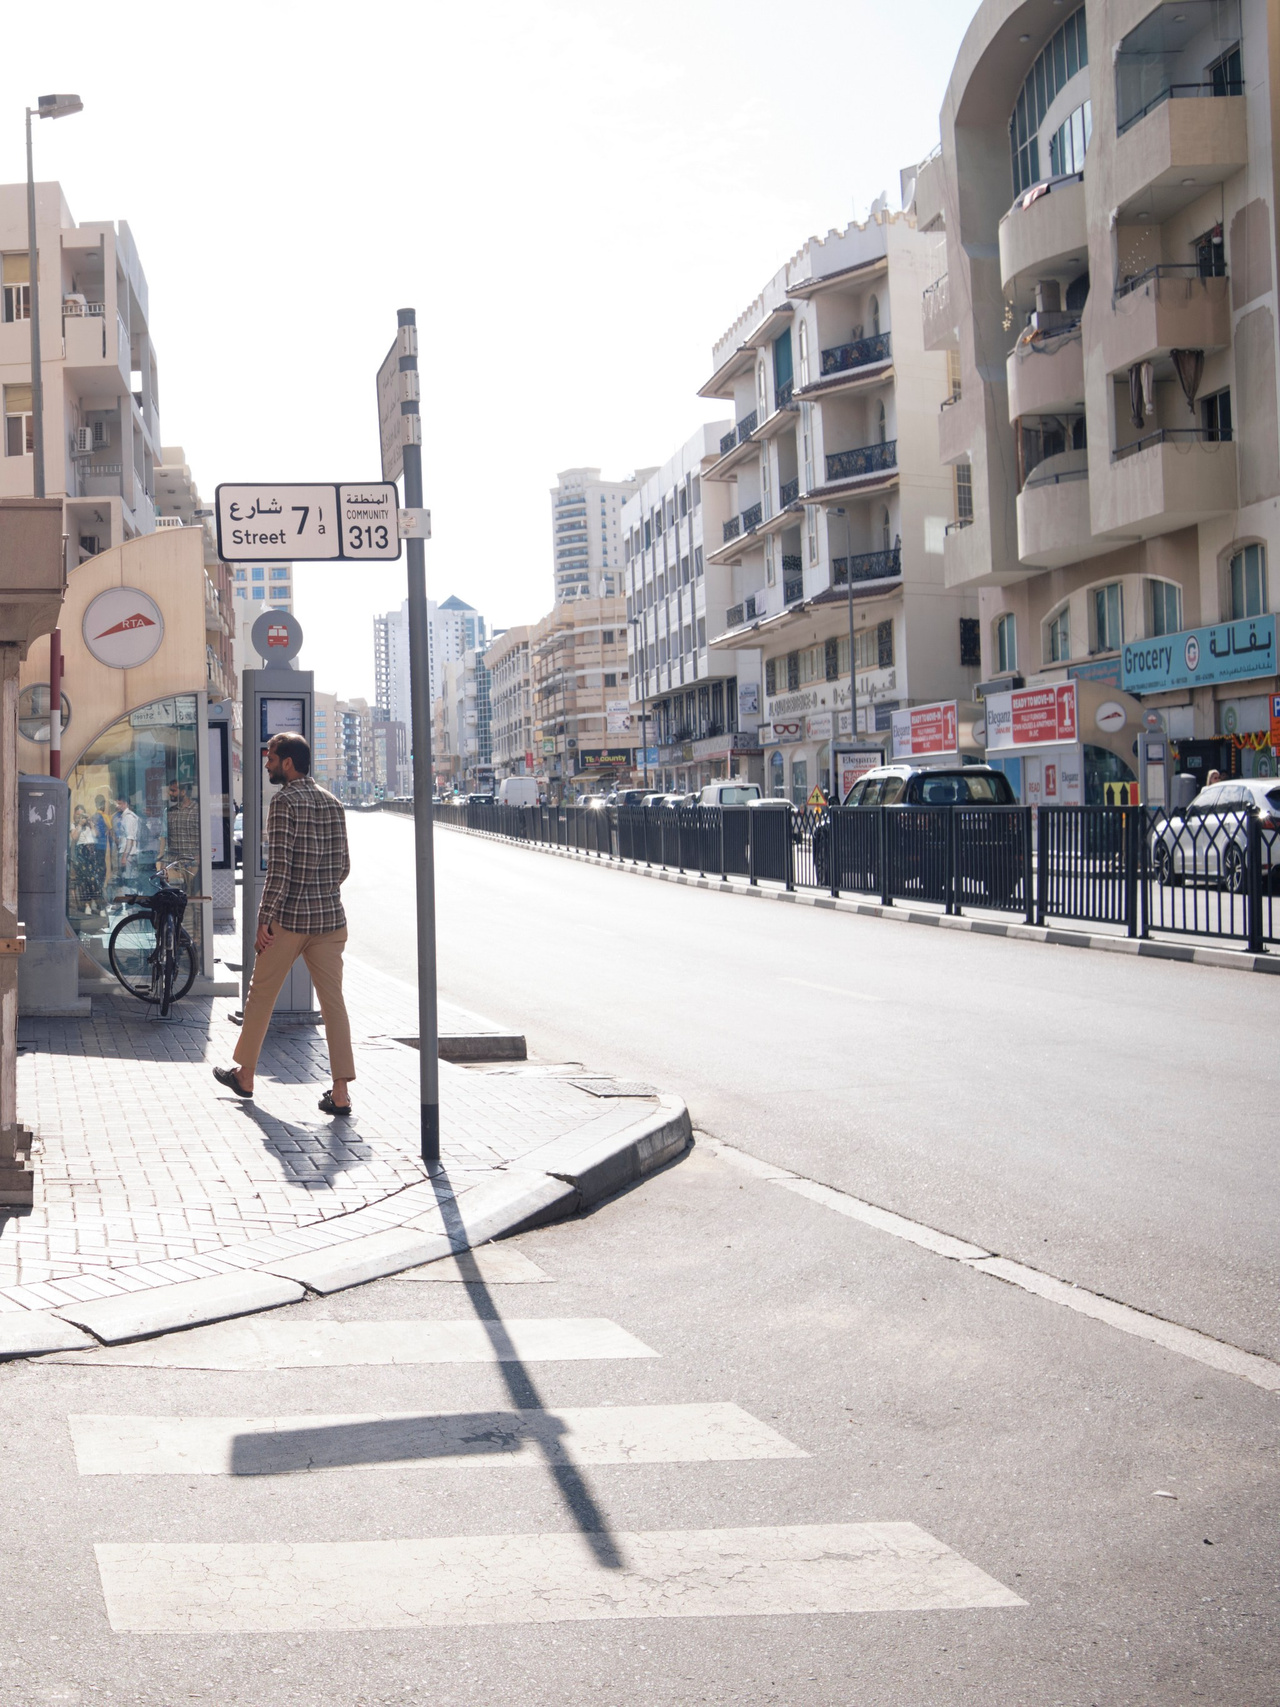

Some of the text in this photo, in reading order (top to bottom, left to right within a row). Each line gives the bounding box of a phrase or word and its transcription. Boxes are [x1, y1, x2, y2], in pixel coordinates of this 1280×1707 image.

[346, 493, 388, 505] المنطقة
[229, 498, 282, 521] شارع
[346, 510, 388, 520] COMMUNITY
[291, 506, 309, 535] 7
[232, 529, 286, 545] Street
[318, 524, 326, 535] a
[349, 525, 388, 549] 313
[122, 619, 145, 628] RTA
[1210, 623, 1272, 658] بقالة
[1125, 646, 1172, 675] Grocery
[988, 710, 1011, 727] Eleganz
[842, 756, 877, 765] Eleganz
